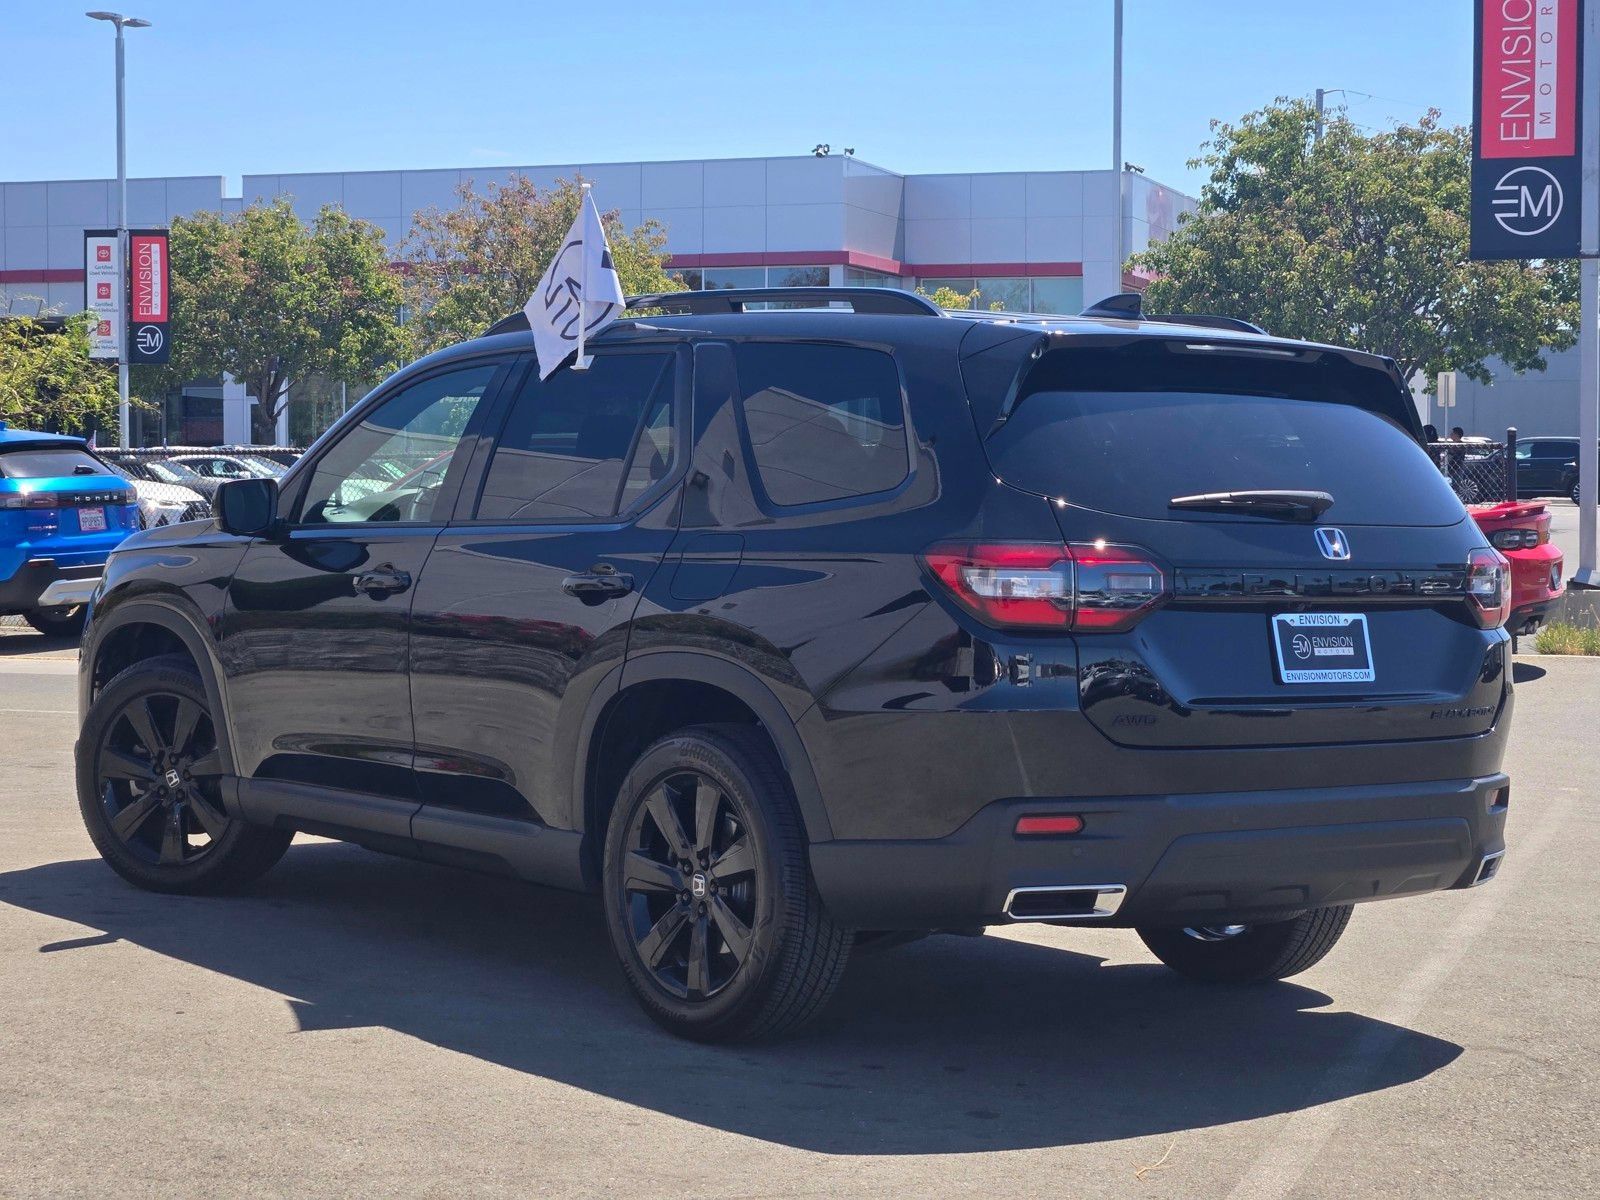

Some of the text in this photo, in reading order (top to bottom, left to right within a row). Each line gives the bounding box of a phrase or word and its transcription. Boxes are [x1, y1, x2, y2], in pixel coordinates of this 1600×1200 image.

[139, 243, 152, 316] ENVISION
[1299, 615, 1340, 625] ENVISION
[1312, 636, 1354, 648] ENVISION
[1286, 671, 1371, 681] ENVISIONMOTORS.COM
